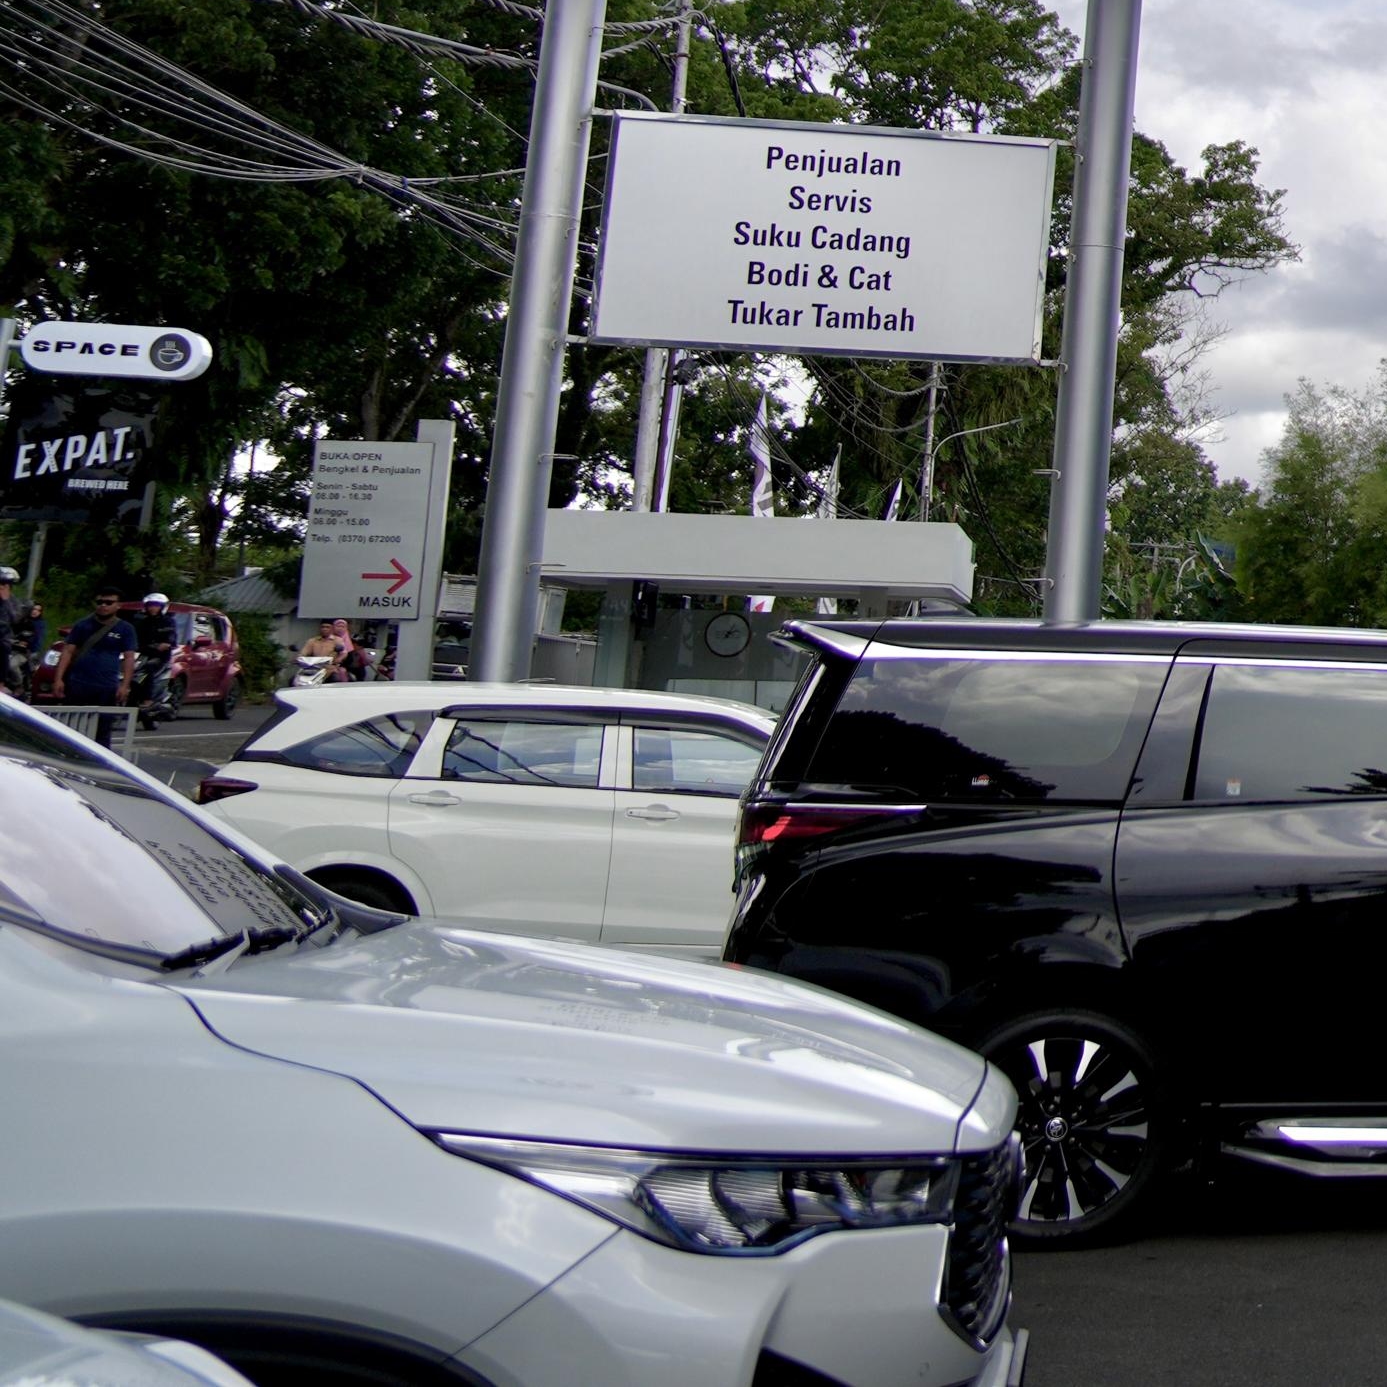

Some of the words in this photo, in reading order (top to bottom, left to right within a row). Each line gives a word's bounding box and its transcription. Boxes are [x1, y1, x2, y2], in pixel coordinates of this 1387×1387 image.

[766, 146, 902, 178] Penjualan
[788, 186, 872, 214] Servis
[733, 221, 801, 249] Suku
[811, 225, 911, 259] Cadang
[747, 262, 809, 288] Bodi
[817, 265, 839, 289] &
[849, 266, 893, 291] Cat
[727, 300, 803, 327] Tukar
[812, 304, 916, 332] Tambah
[32, 340, 139, 356] SPACE
[319, 465, 359, 475] Bengkel
[363, 466, 369, 474] &
[372, 467, 420, 476] Penjualan
[359, 597, 412, 607] MASUK
